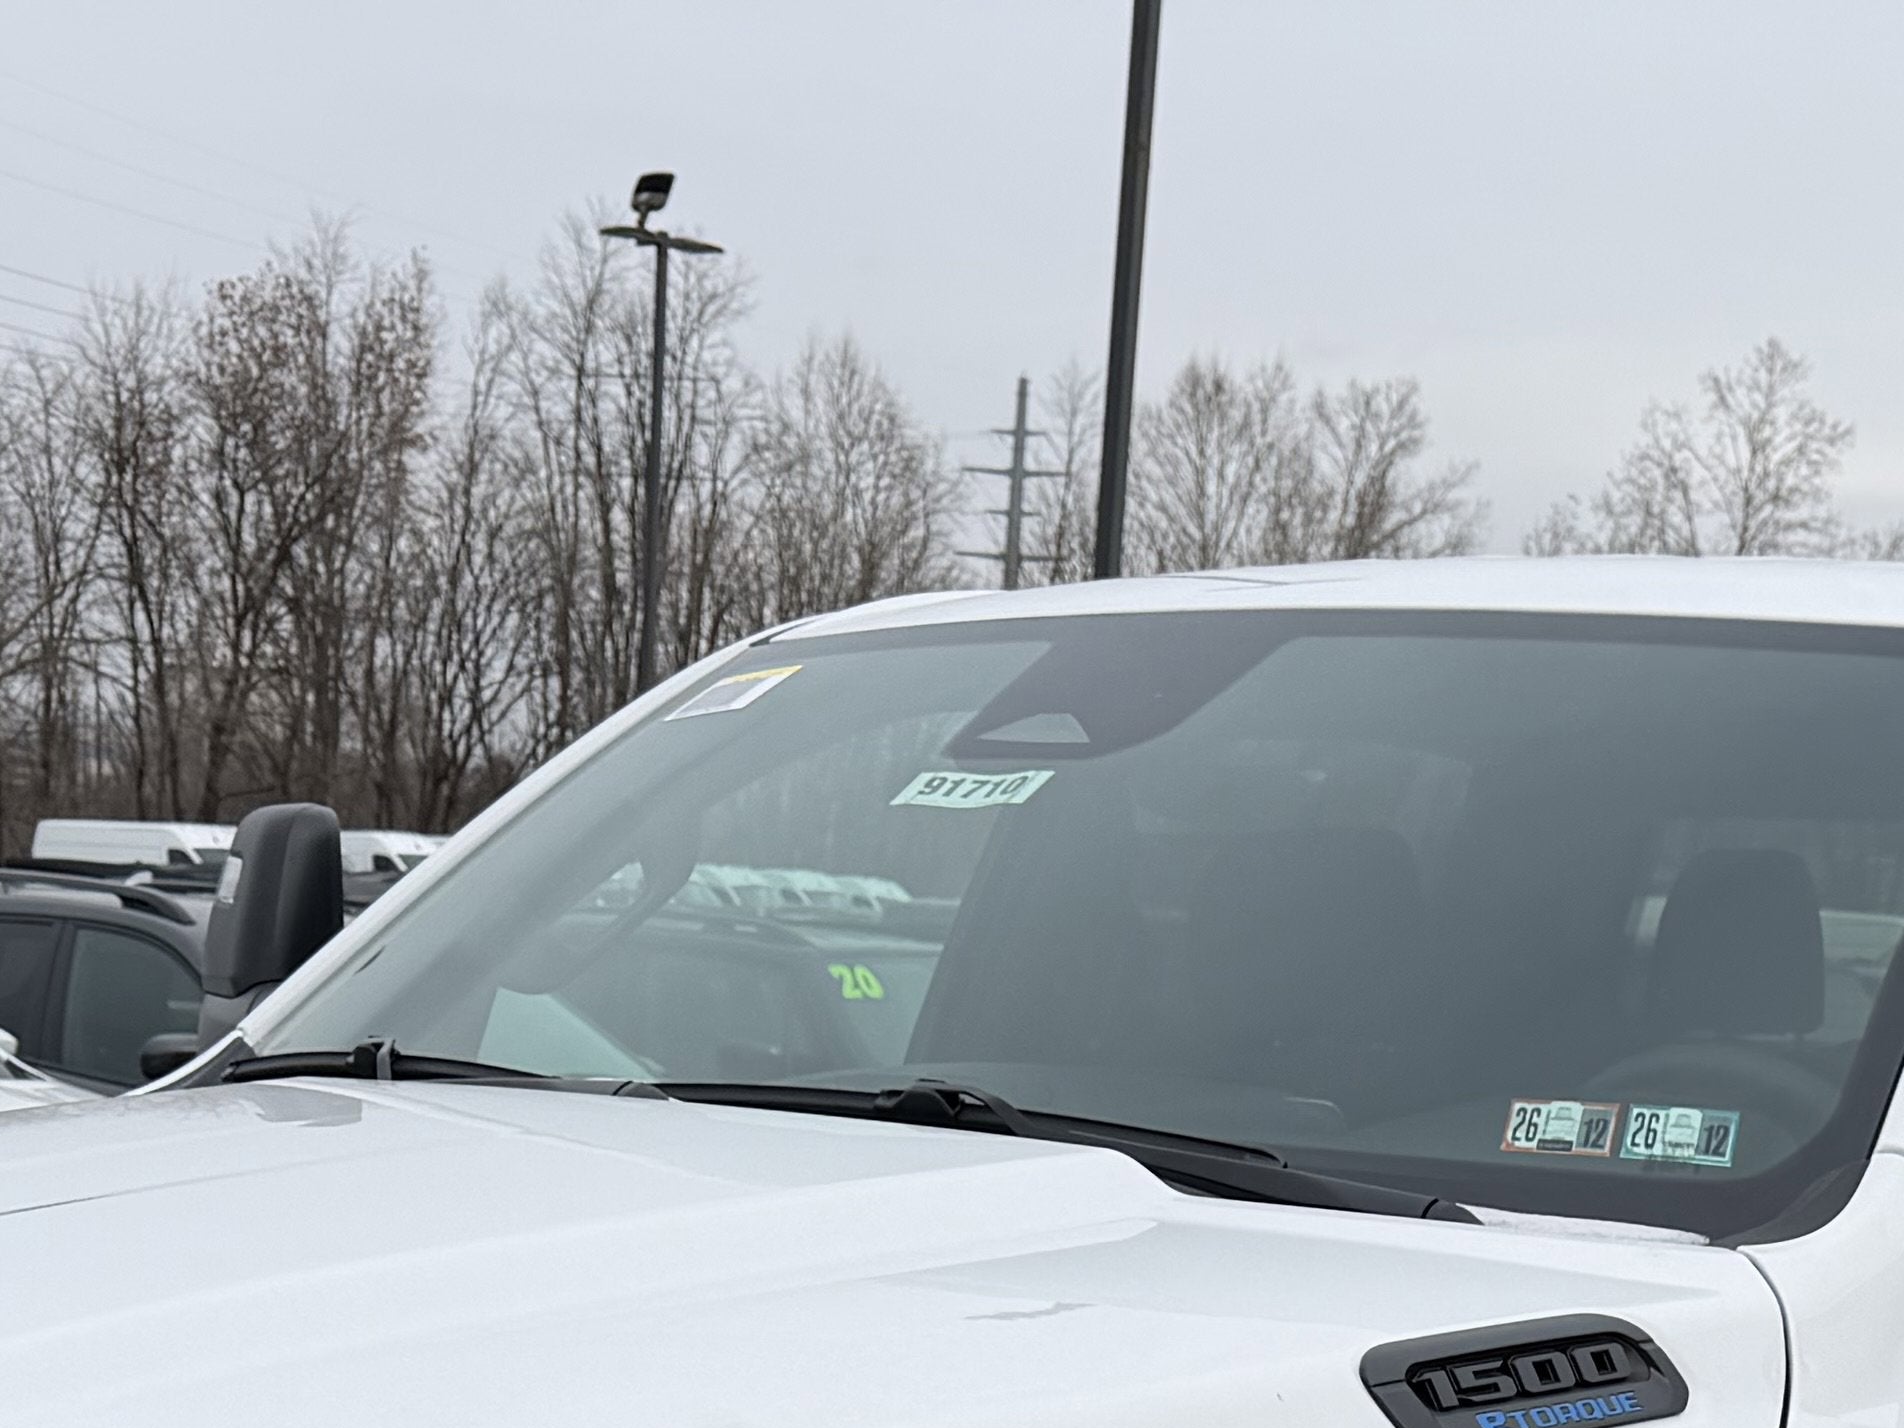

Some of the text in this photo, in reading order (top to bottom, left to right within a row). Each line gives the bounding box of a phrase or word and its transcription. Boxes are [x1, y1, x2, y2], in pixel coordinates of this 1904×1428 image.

[917, 775, 1029, 799] 91710
[827, 963, 884, 999] 20
[1510, 1106, 1610, 1149] 26 12
[1629, 1112, 1731, 1157] 26 12
[1413, 1342, 1632, 1409] 1500
